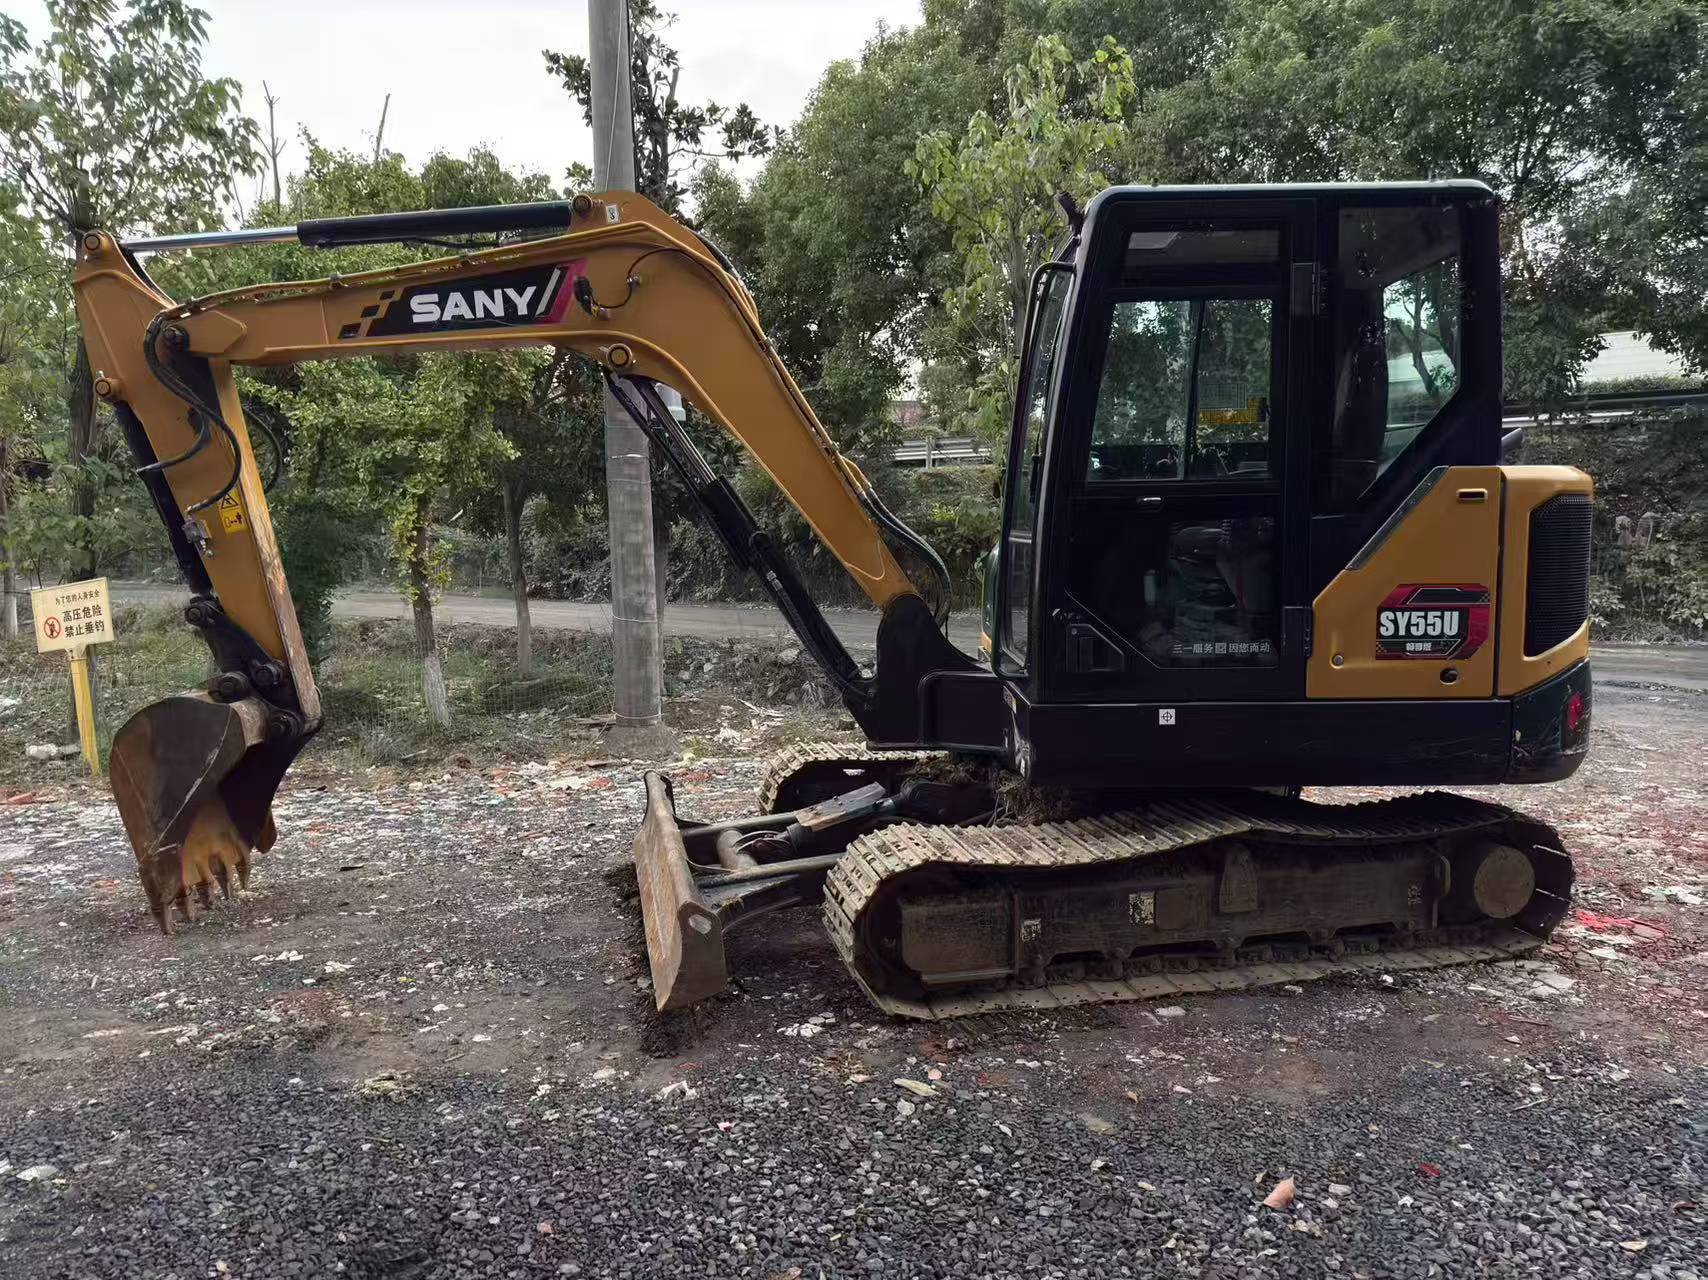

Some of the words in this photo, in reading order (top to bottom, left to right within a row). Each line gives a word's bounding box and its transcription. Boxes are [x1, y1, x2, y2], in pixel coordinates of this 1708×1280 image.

[409, 286, 537, 323] SANY
[62, 604, 103, 622] 高压危险
[64, 620, 105, 638] 禁止垂钓
[1380, 611, 1459, 636] SY55U
[1172, 643, 1214, 654] 三一服务
[1228, 642, 1270, 653] 因您而动
